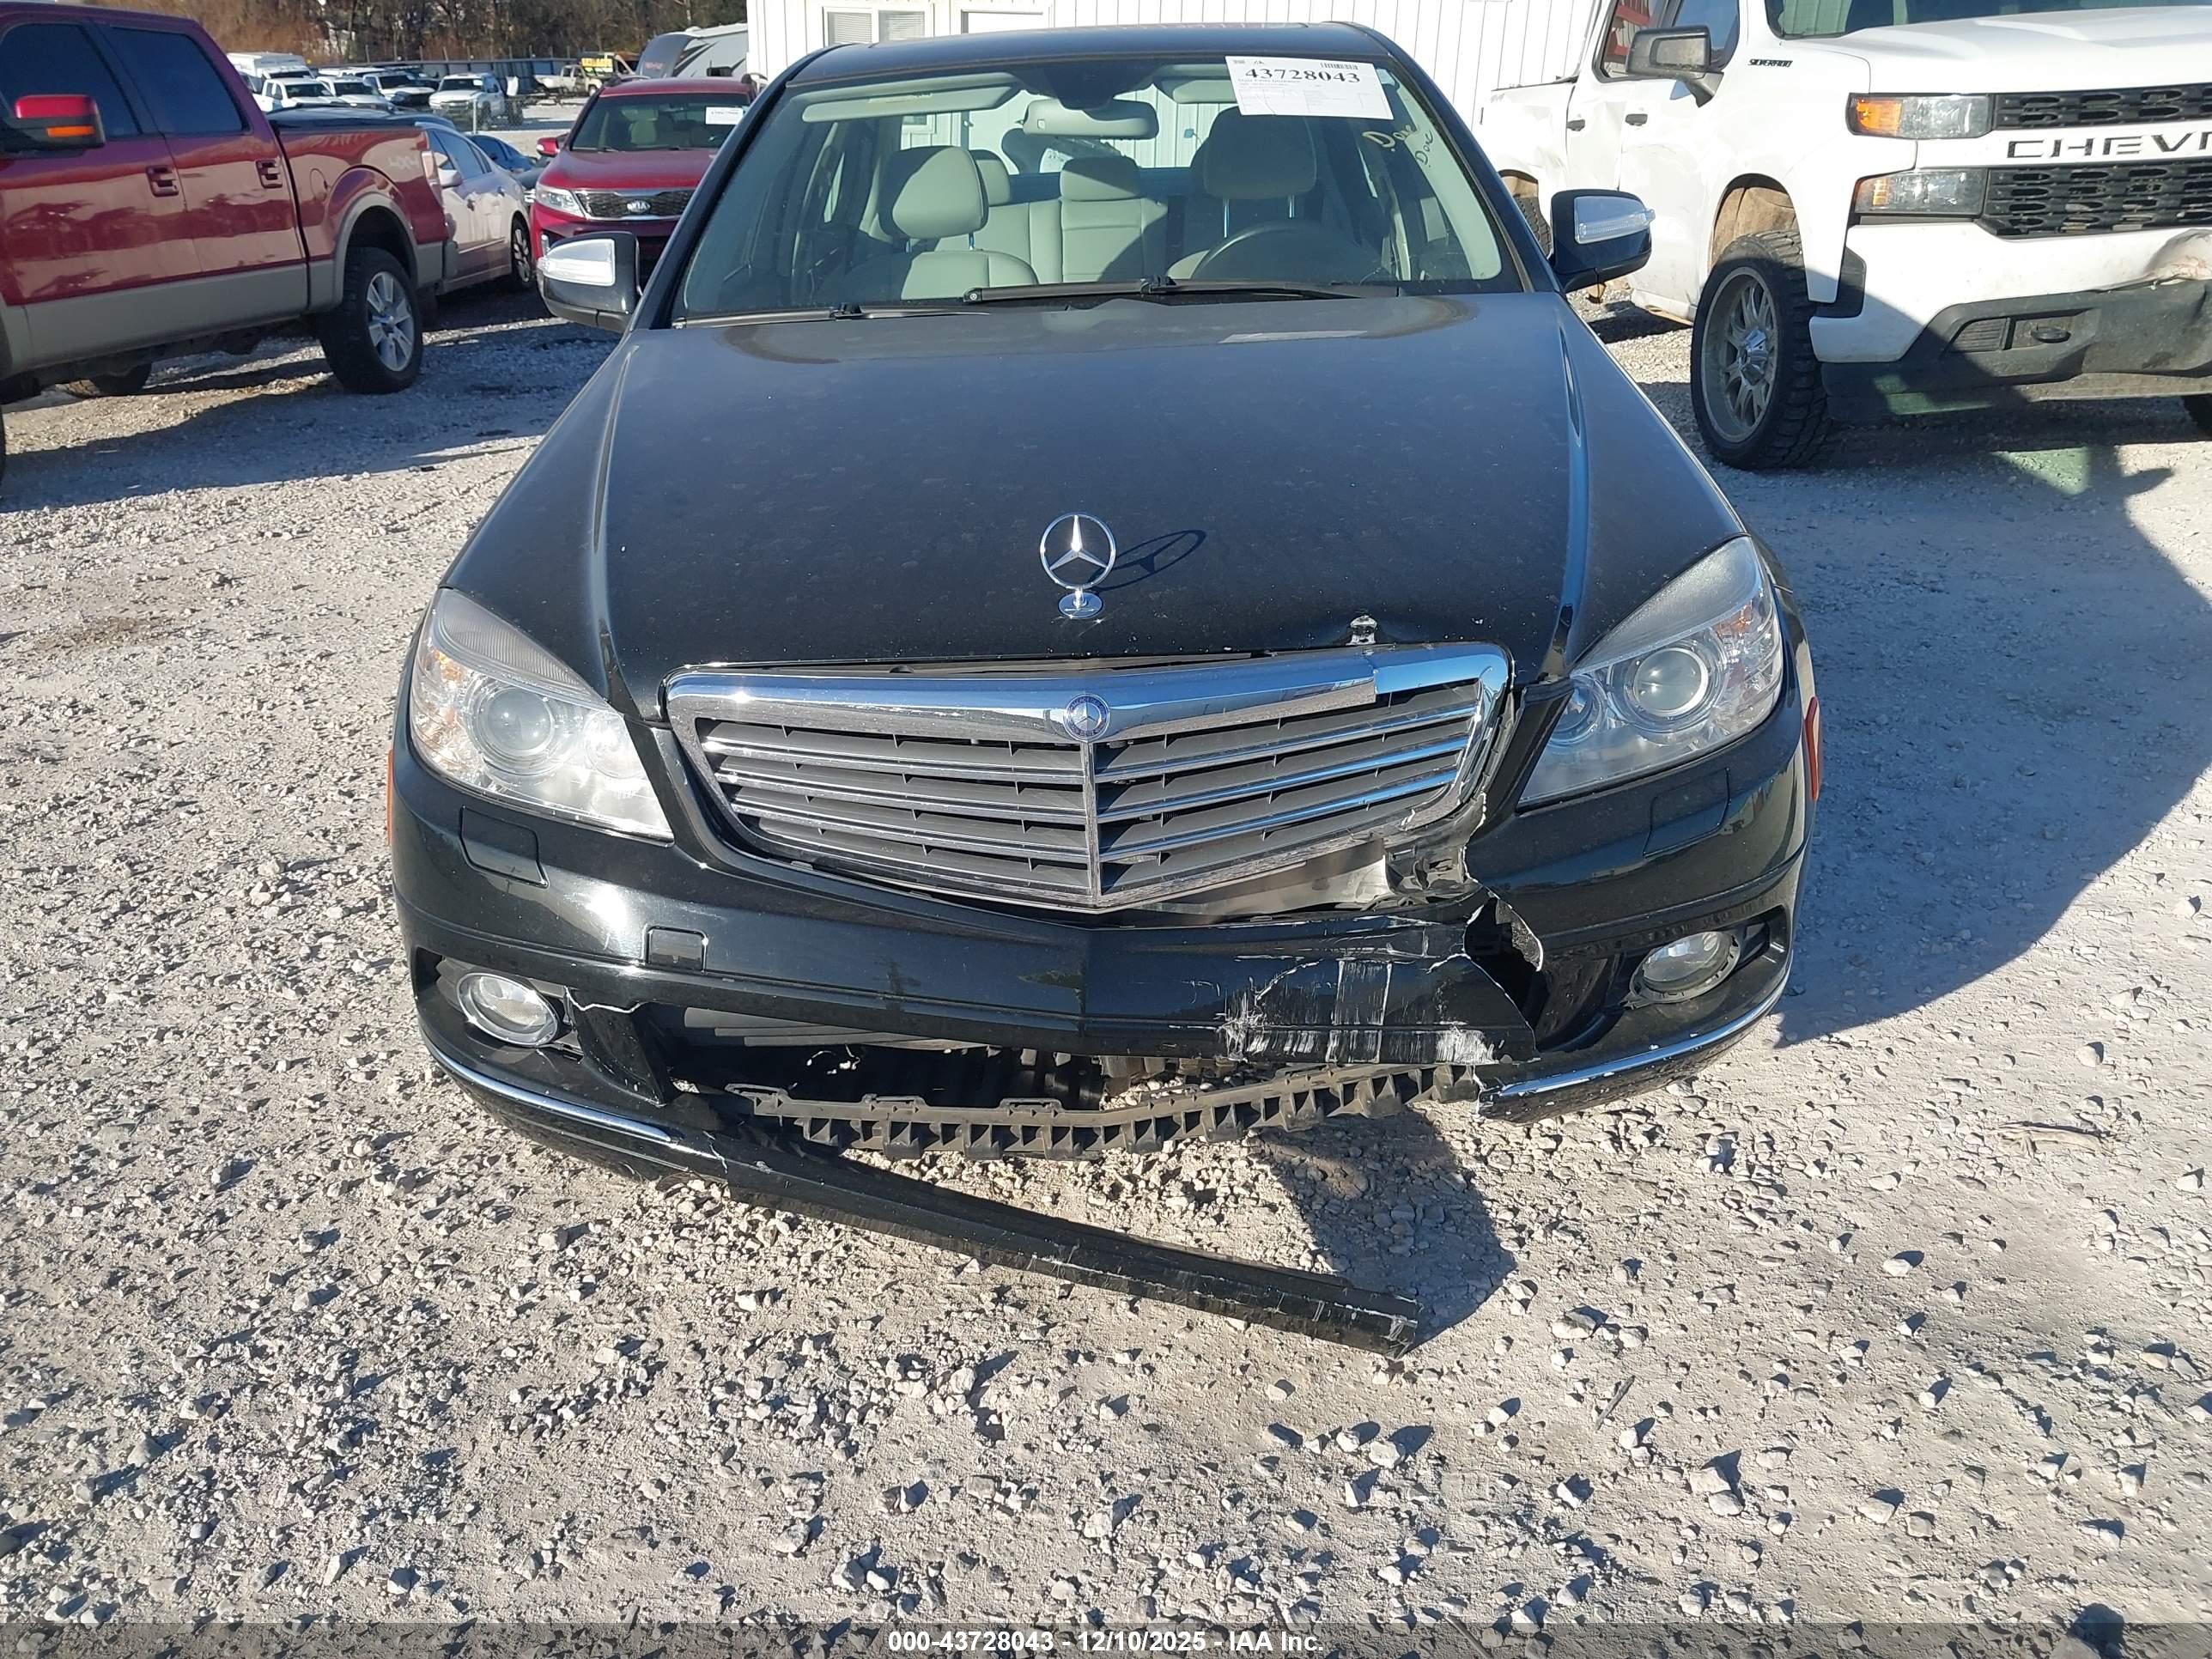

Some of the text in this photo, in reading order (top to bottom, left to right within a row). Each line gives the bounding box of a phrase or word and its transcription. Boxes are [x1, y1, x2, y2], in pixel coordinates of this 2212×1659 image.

[1747, 58, 1793, 68] SILVERADO
[1245, 68, 1360, 83] 43728043
[629, 200, 649, 211] KIA
